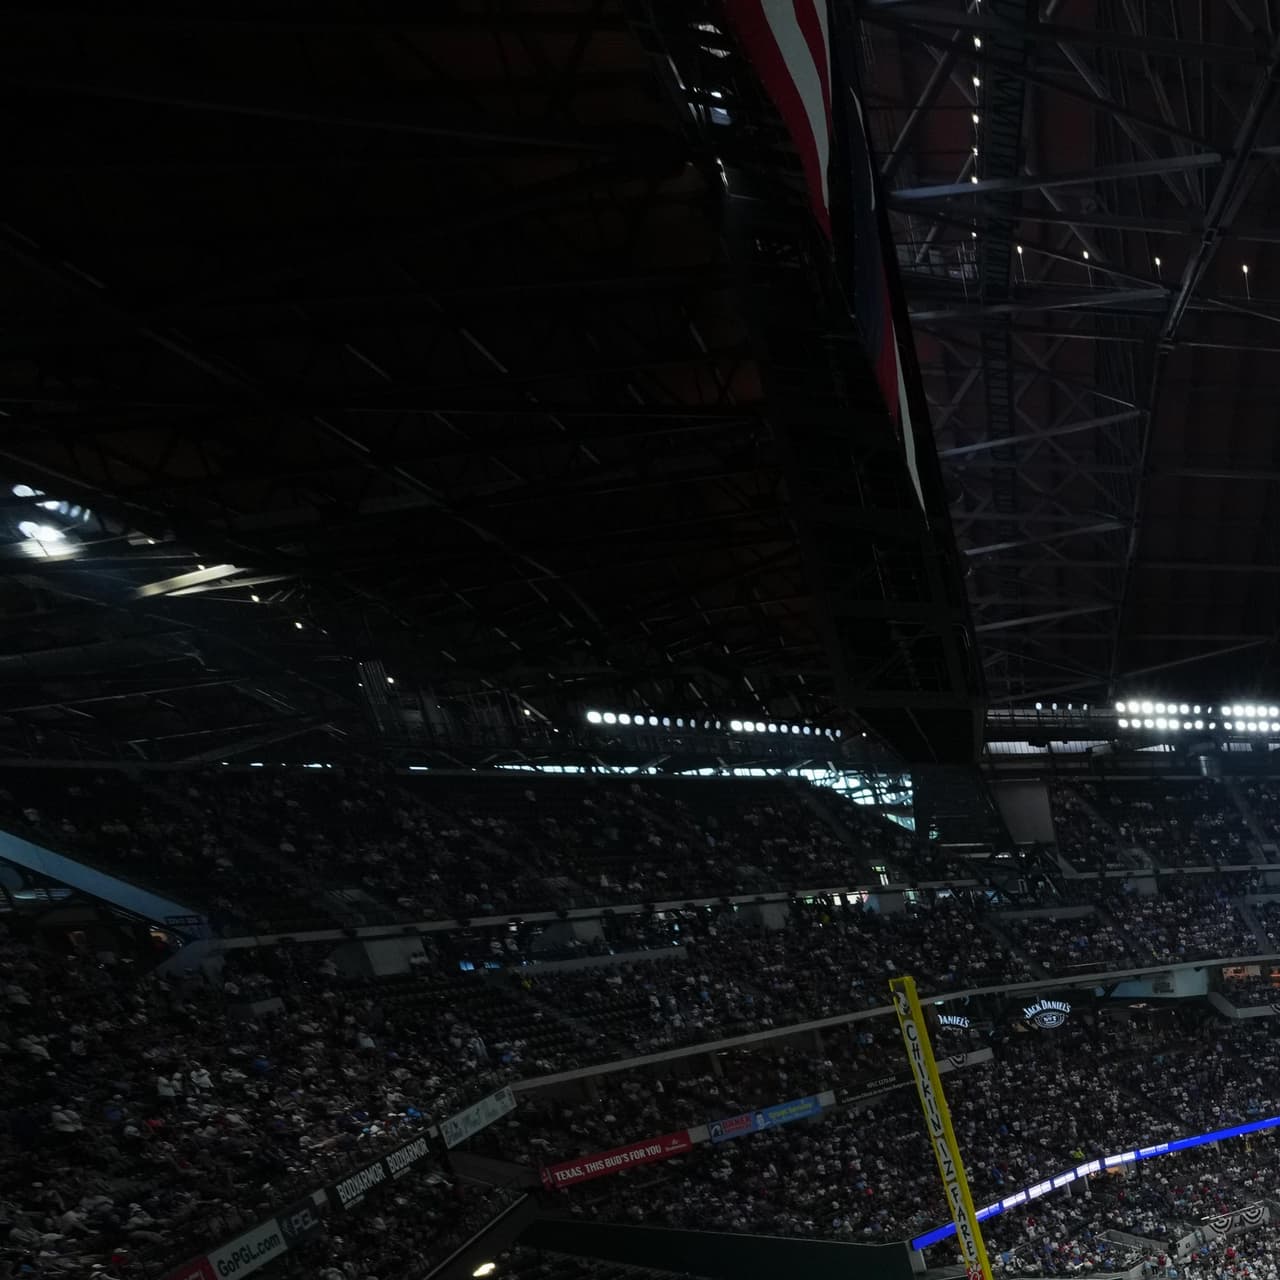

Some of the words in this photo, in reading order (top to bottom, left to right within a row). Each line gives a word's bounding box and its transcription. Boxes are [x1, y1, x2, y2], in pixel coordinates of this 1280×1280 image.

[1023, 1000, 1042, 1019] JACK
[1040, 999, 1072, 1014] DANIEL'S
[906, 1024, 942, 1131] CHIKIN
[336, 1162, 387, 1204] BODYARMOR
[553, 1165, 585, 1182] TEXAS,
[584, 1160, 605, 1174] THIS
[605, 1153, 631, 1169] BUD'S
[629, 1149, 647, 1164] FOR
[644, 1143, 662, 1158] YOU
[951, 1186, 973, 1257] FARE
[216, 1230, 281, 1278] GoPGL.com
